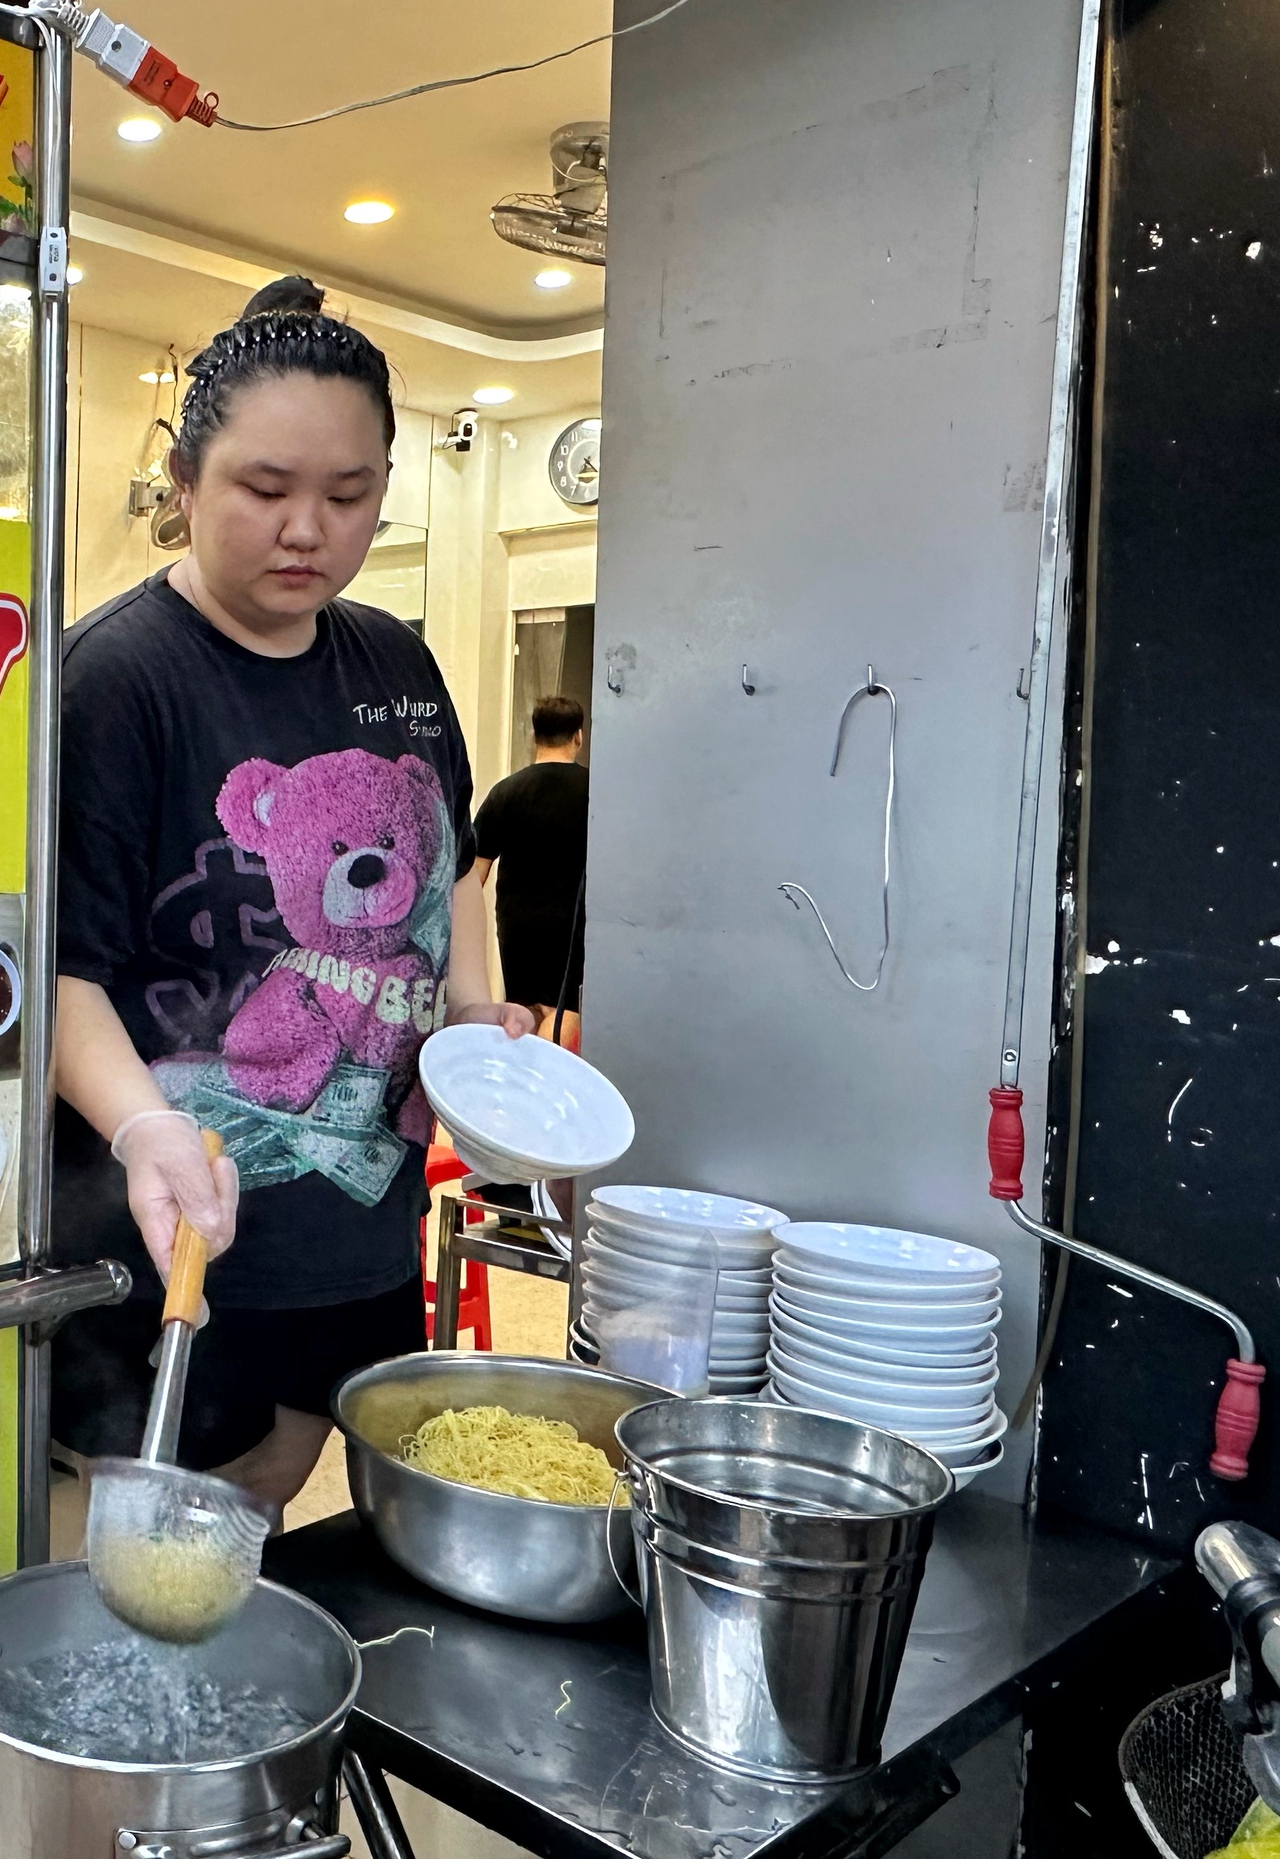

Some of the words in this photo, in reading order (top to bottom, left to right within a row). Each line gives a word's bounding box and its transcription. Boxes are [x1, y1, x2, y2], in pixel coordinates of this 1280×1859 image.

[557, 460, 564, 471] 9
[560, 476, 567, 487] 8
[570, 485, 577, 496] 7
[352, 703, 387, 724] THE
